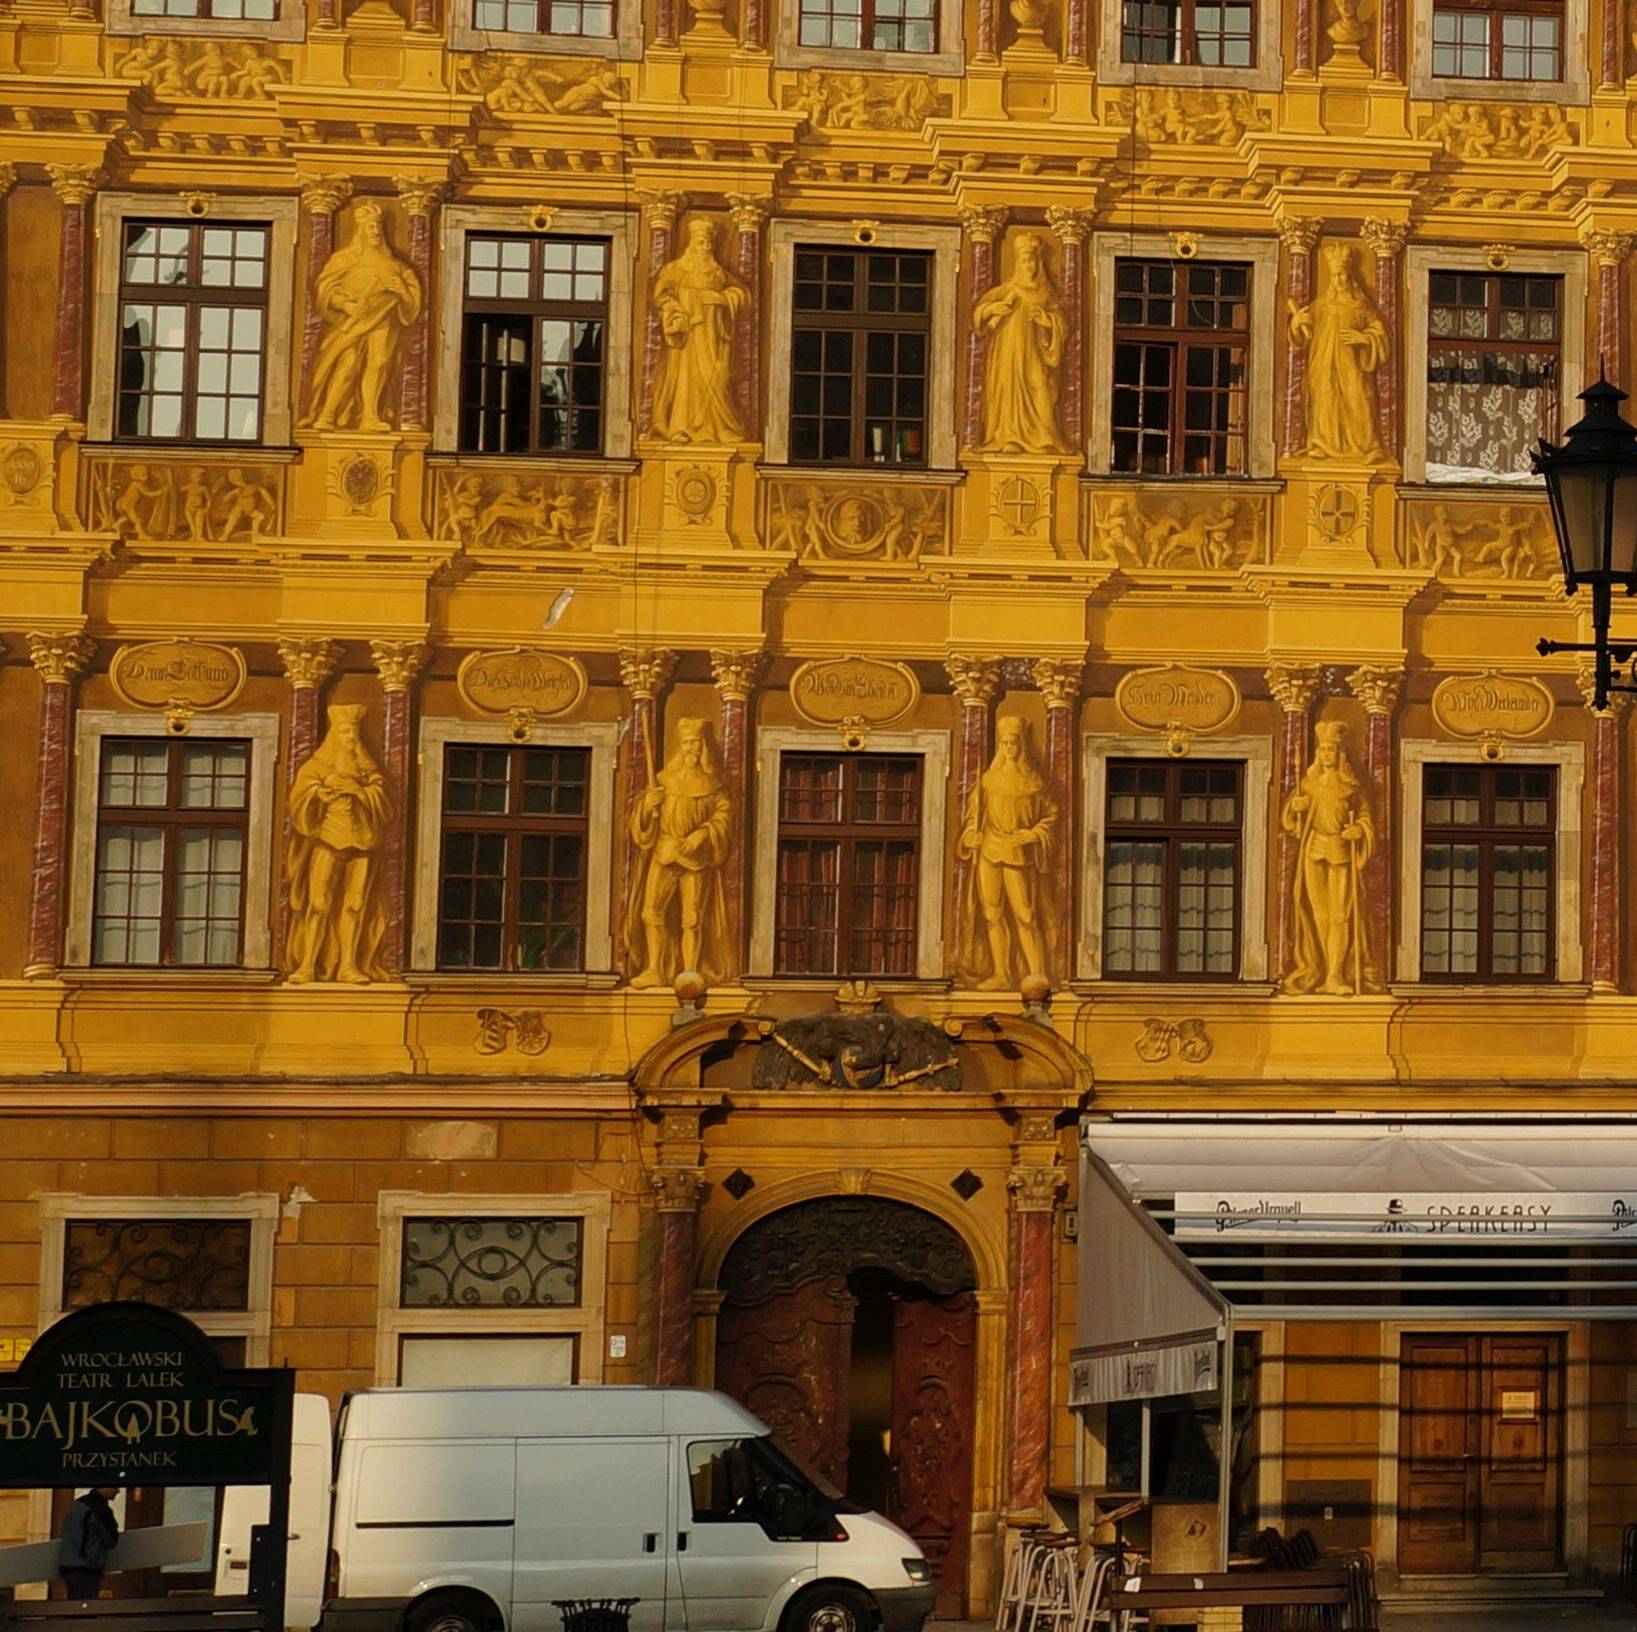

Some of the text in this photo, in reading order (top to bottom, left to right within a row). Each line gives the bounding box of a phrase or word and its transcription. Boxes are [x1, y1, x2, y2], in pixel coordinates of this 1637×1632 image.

[1426, 1205, 1552, 1232] SPEAKEASY
[59, 1351, 184, 1368] WROCŁAWSKI
[57, 1371, 184, 1389] TEATR LALEK
[5, 1399, 242, 1450] BAJKOBUS
[61, 1451, 178, 1468] PRZYSTANEK
